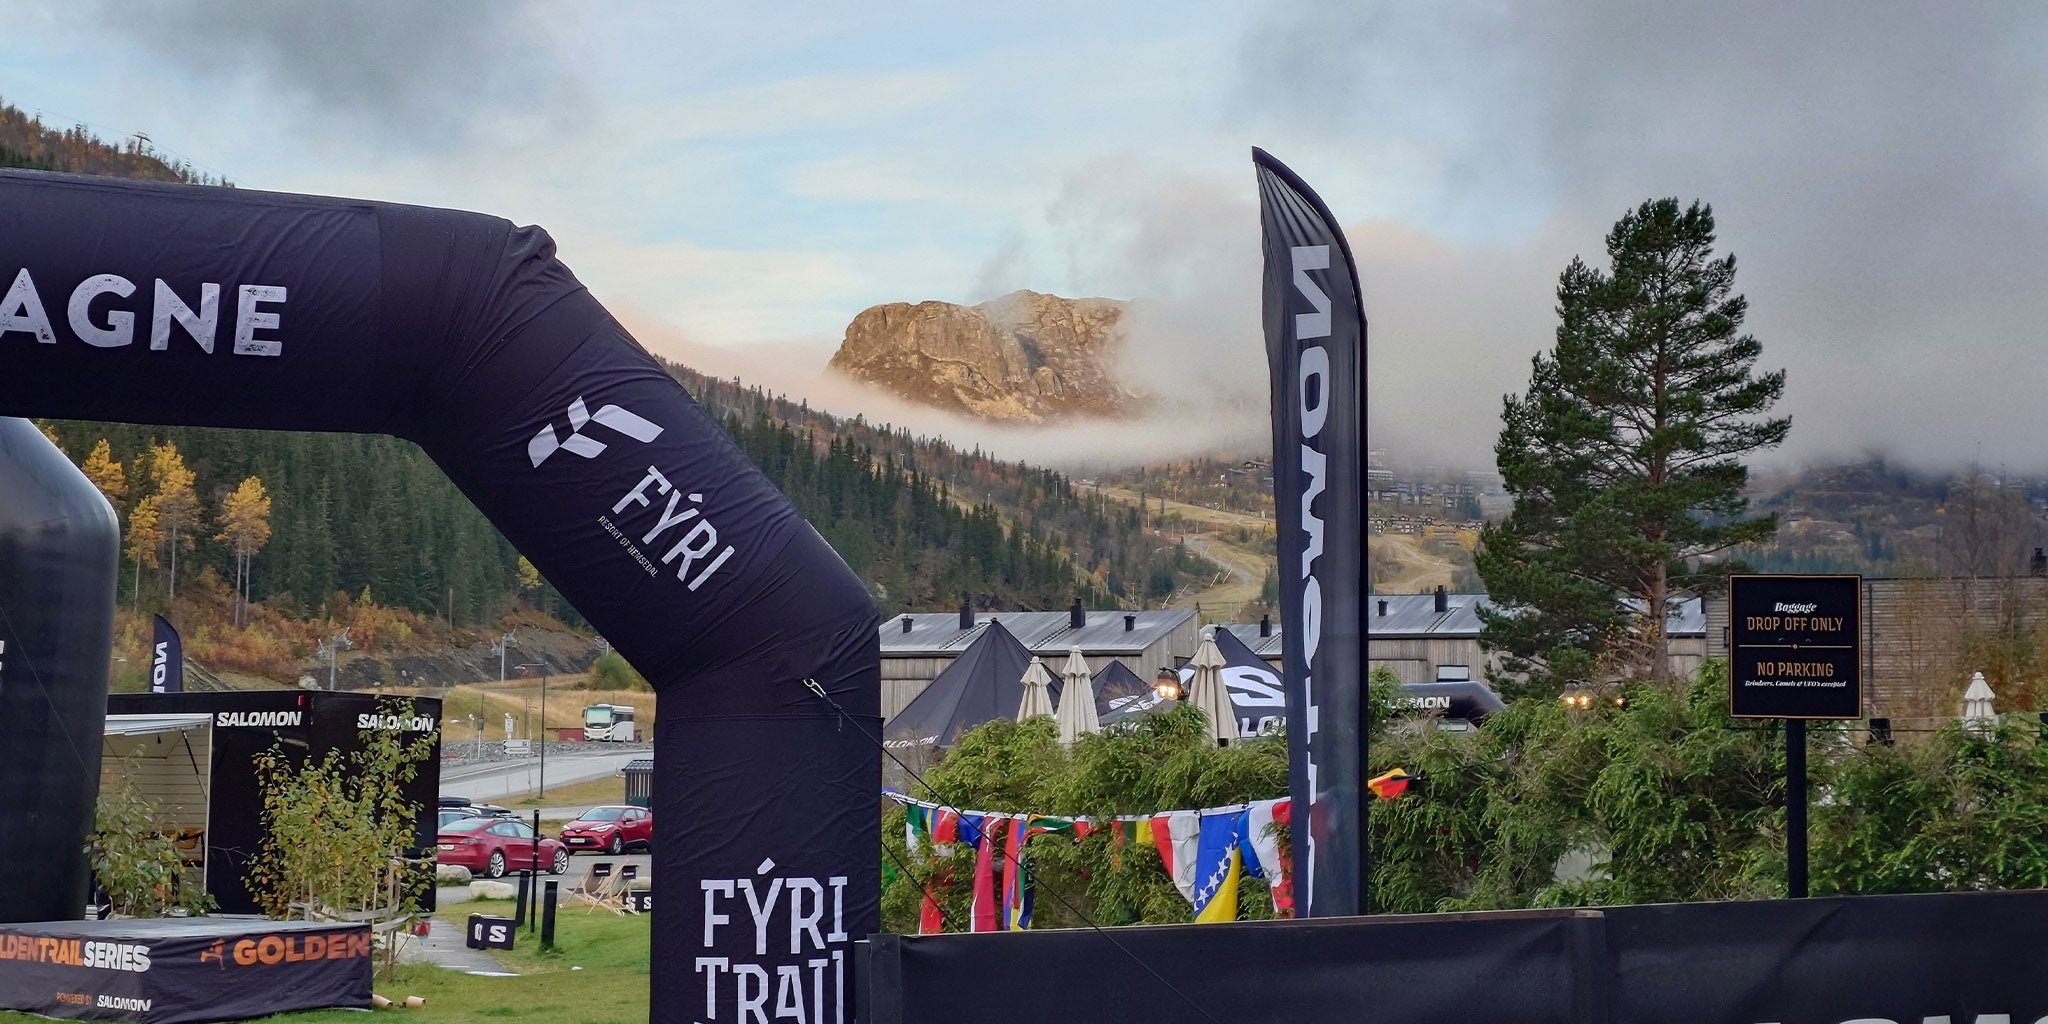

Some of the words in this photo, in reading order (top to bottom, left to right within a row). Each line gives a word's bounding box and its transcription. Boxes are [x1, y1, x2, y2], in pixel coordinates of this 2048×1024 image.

[0, 267, 287, 356] AGNE
[597, 515, 623, 540] RESORT
[619, 537, 631, 548] OF
[611, 465, 736, 592] FÝRI
[1774, 602, 1817, 613] Baggage
[1746, 616, 1780, 631] DROP
[1784, 617, 1807, 631] OFF
[1811, 617, 1843, 631] ONLY
[1757, 661, 1775, 676] NO
[1778, 662, 1834, 677] PARKING
[216, 711, 302, 727] SALOMON
[700, 857, 848, 955] FÝRI
[233, 932, 371, 966] GOLDEN
[96, 995, 152, 1012] SALOMON
